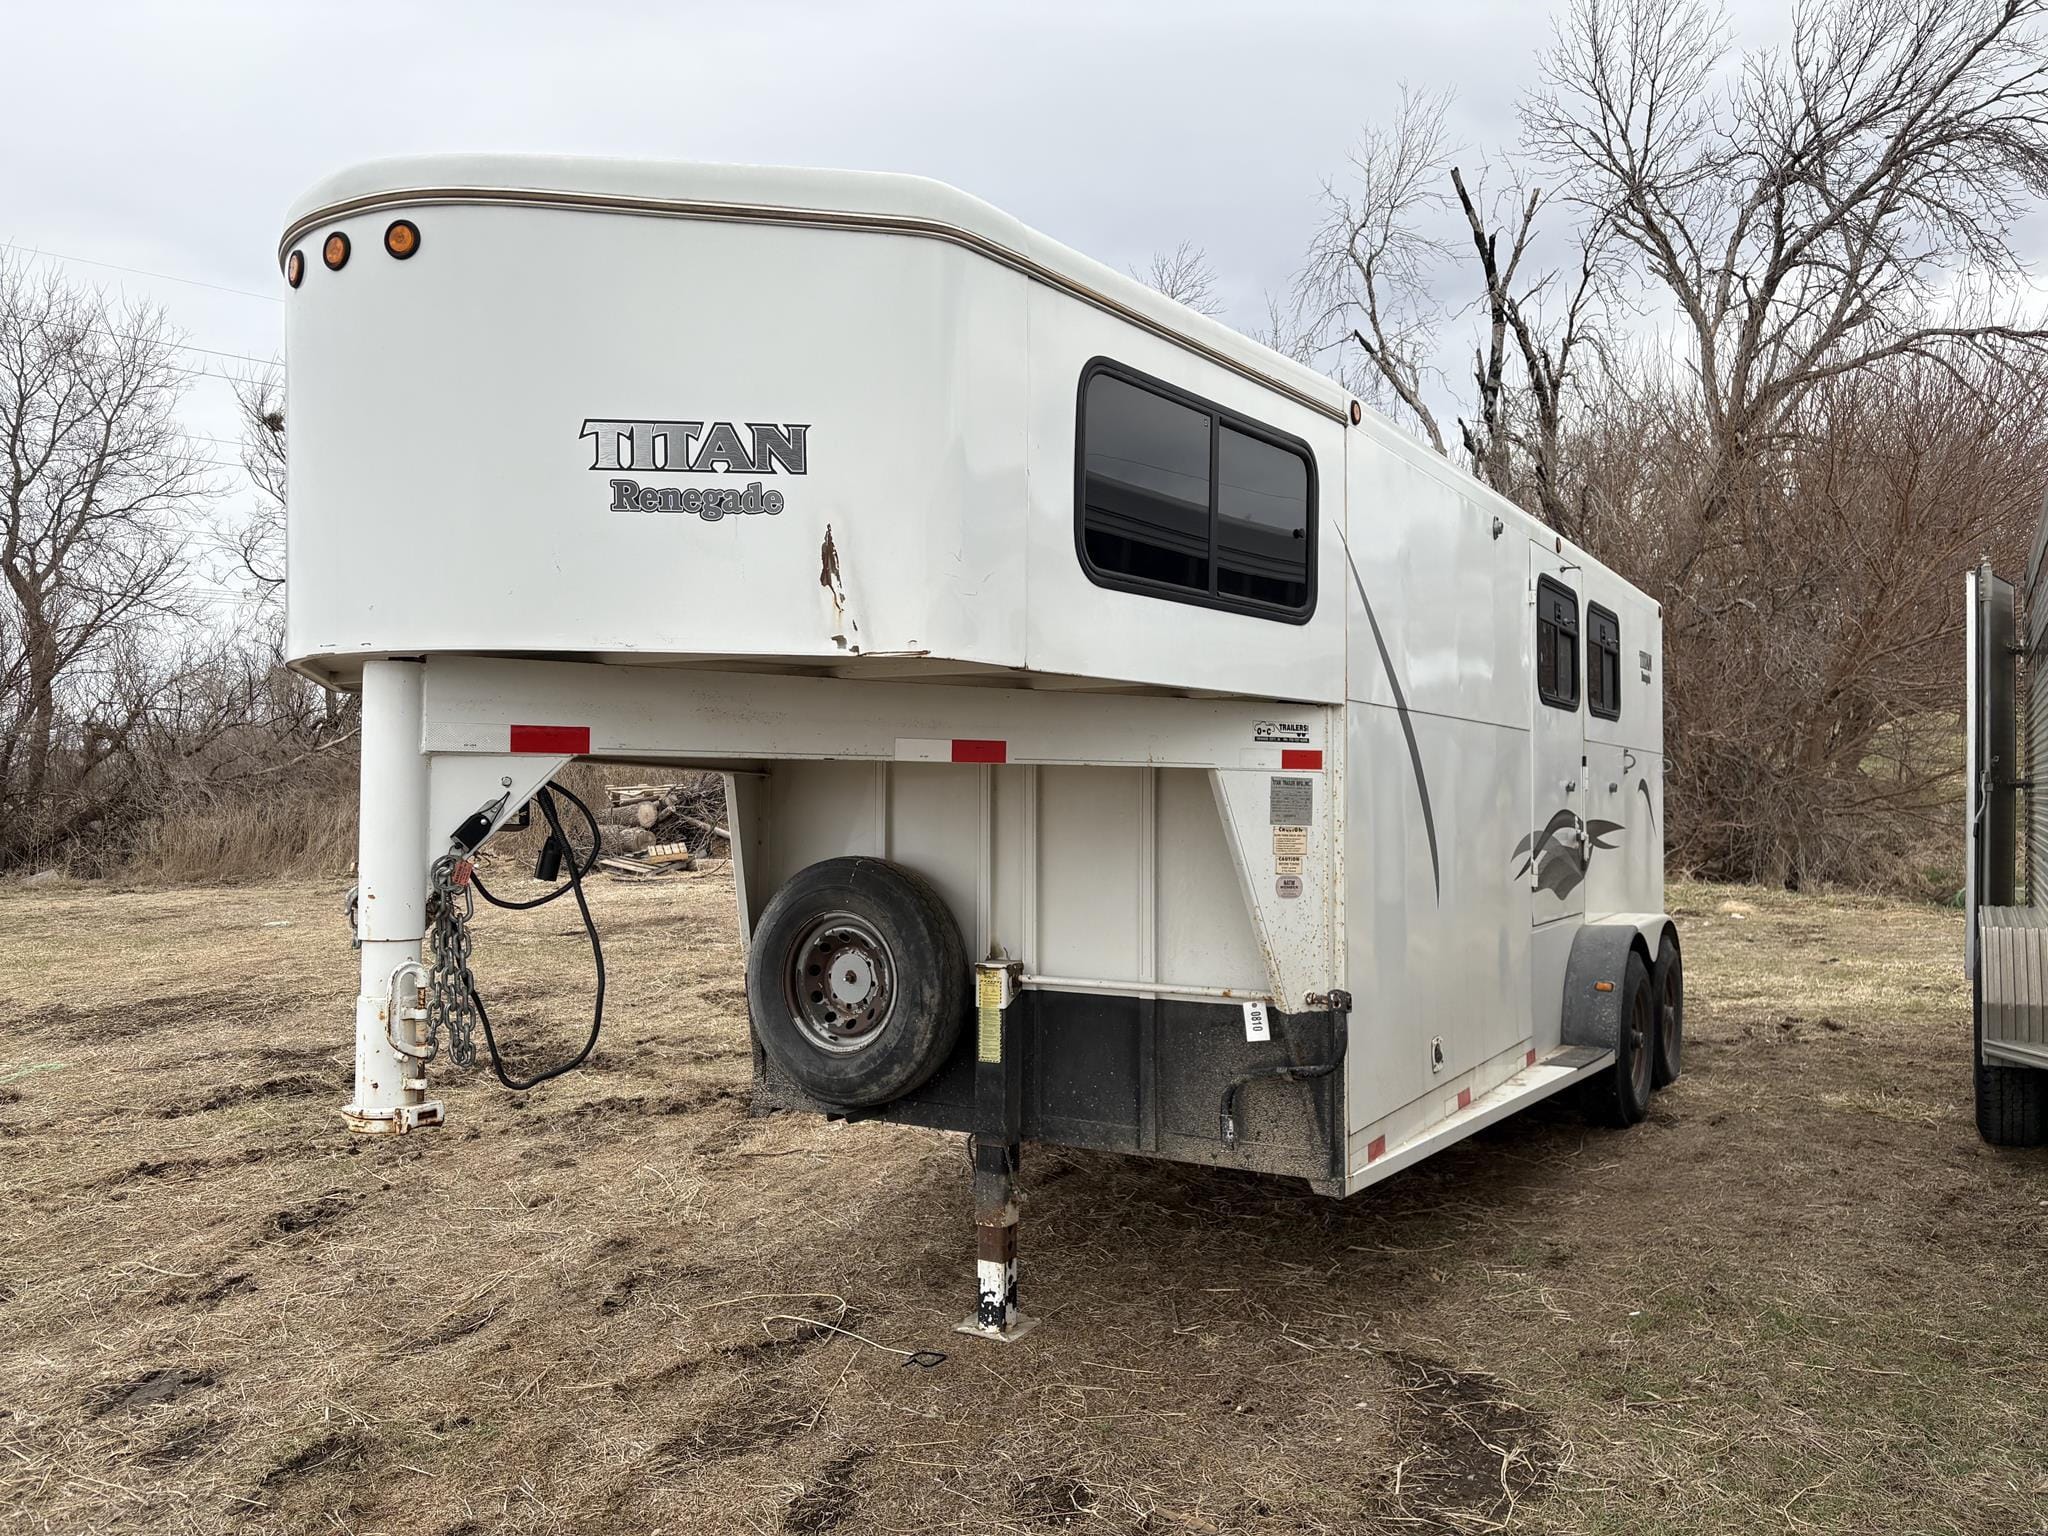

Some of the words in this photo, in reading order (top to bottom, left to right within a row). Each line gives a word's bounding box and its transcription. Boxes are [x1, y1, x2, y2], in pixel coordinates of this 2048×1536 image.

[578, 418, 812, 475] TITAN
[609, 479, 785, 522] Renegade
[1250, 1011, 1263, 1032] 0810
